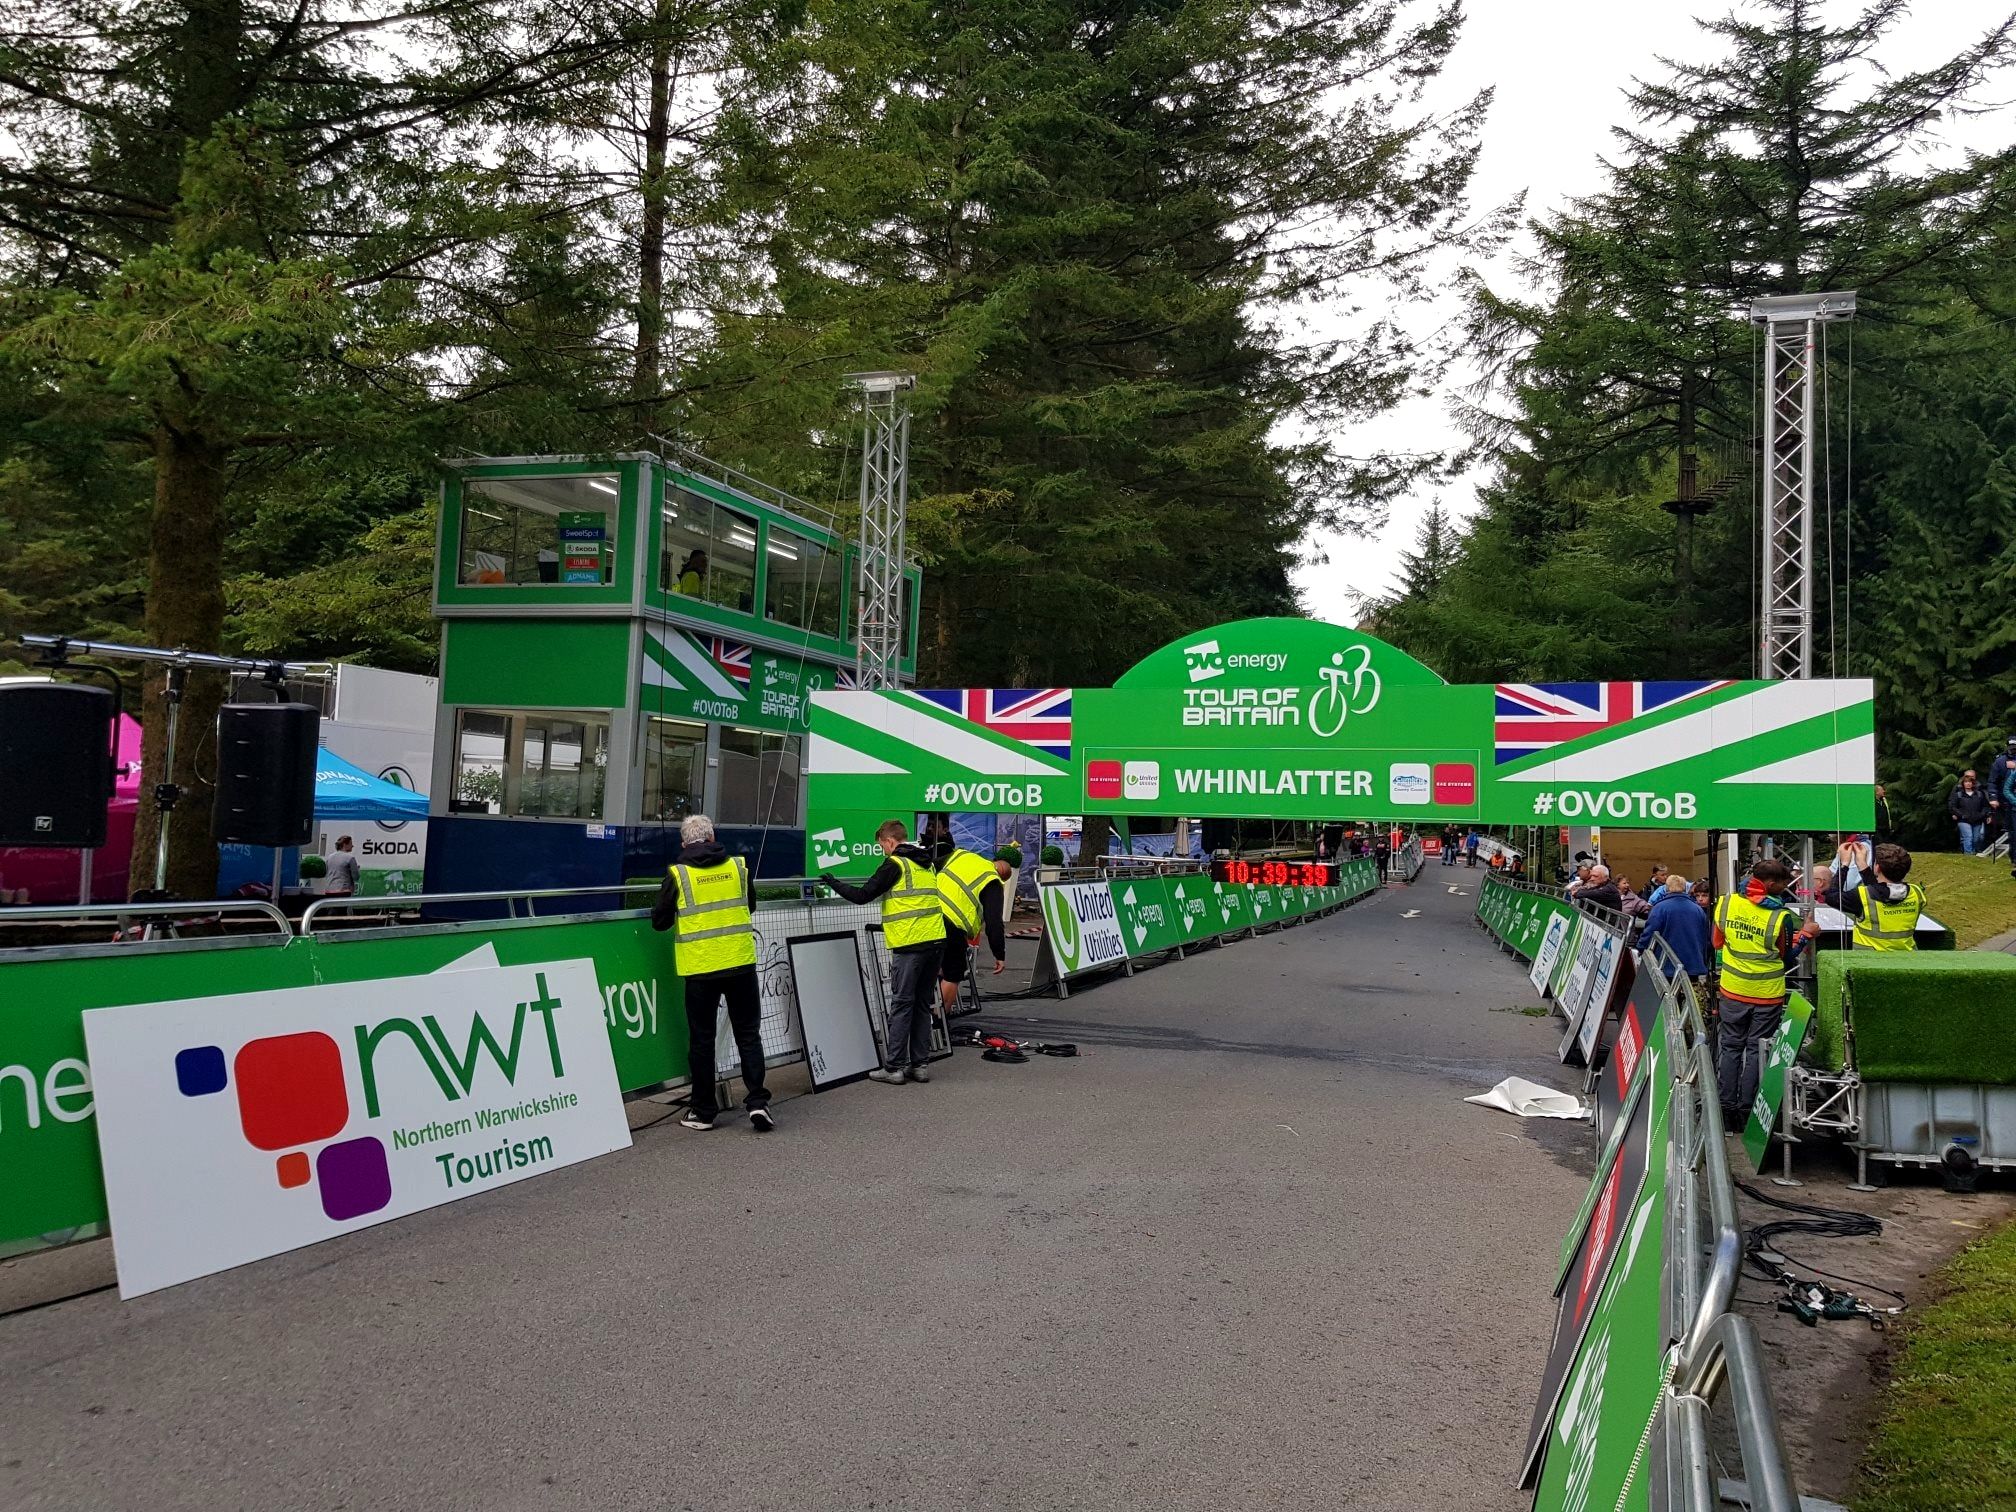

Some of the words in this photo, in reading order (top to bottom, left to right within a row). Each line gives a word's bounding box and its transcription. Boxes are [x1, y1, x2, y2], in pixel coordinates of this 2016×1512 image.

[1227, 653, 1288, 672] energy
[779, 669, 800, 685] energy
[763, 689, 788, 706] TOUR
[789, 694, 800, 706] OF
[1183, 688, 1258, 706] TOUR
[1262, 688, 1300, 706] OF
[693, 699, 739, 720] #OVOToB
[761, 701, 800, 720] BRITAIN
[1183, 706, 1300, 726] BRITAIN
[1174, 769, 1373, 796] WHINLATTER
[924, 782, 1043, 807] #OVOToB
[1532, 789, 1697, 819] #OVOToB
[362, 839, 419, 855] ŠKODA
[1224, 860, 1328, 887] 10:39:39
[1073, 884, 1114, 923] United
[1141, 904, 1165, 927] energy
[1726, 919, 1765, 937] TECHNICAL
[1735, 930, 1754, 942] TEAM
[1084, 928, 1124, 963] Utilities
[354, 972, 565, 1120] nwt
[393, 1118, 472, 1150] Northern
[475, 1092, 578, 1130] Warwickshire
[435, 1135, 554, 1188] Tourism
